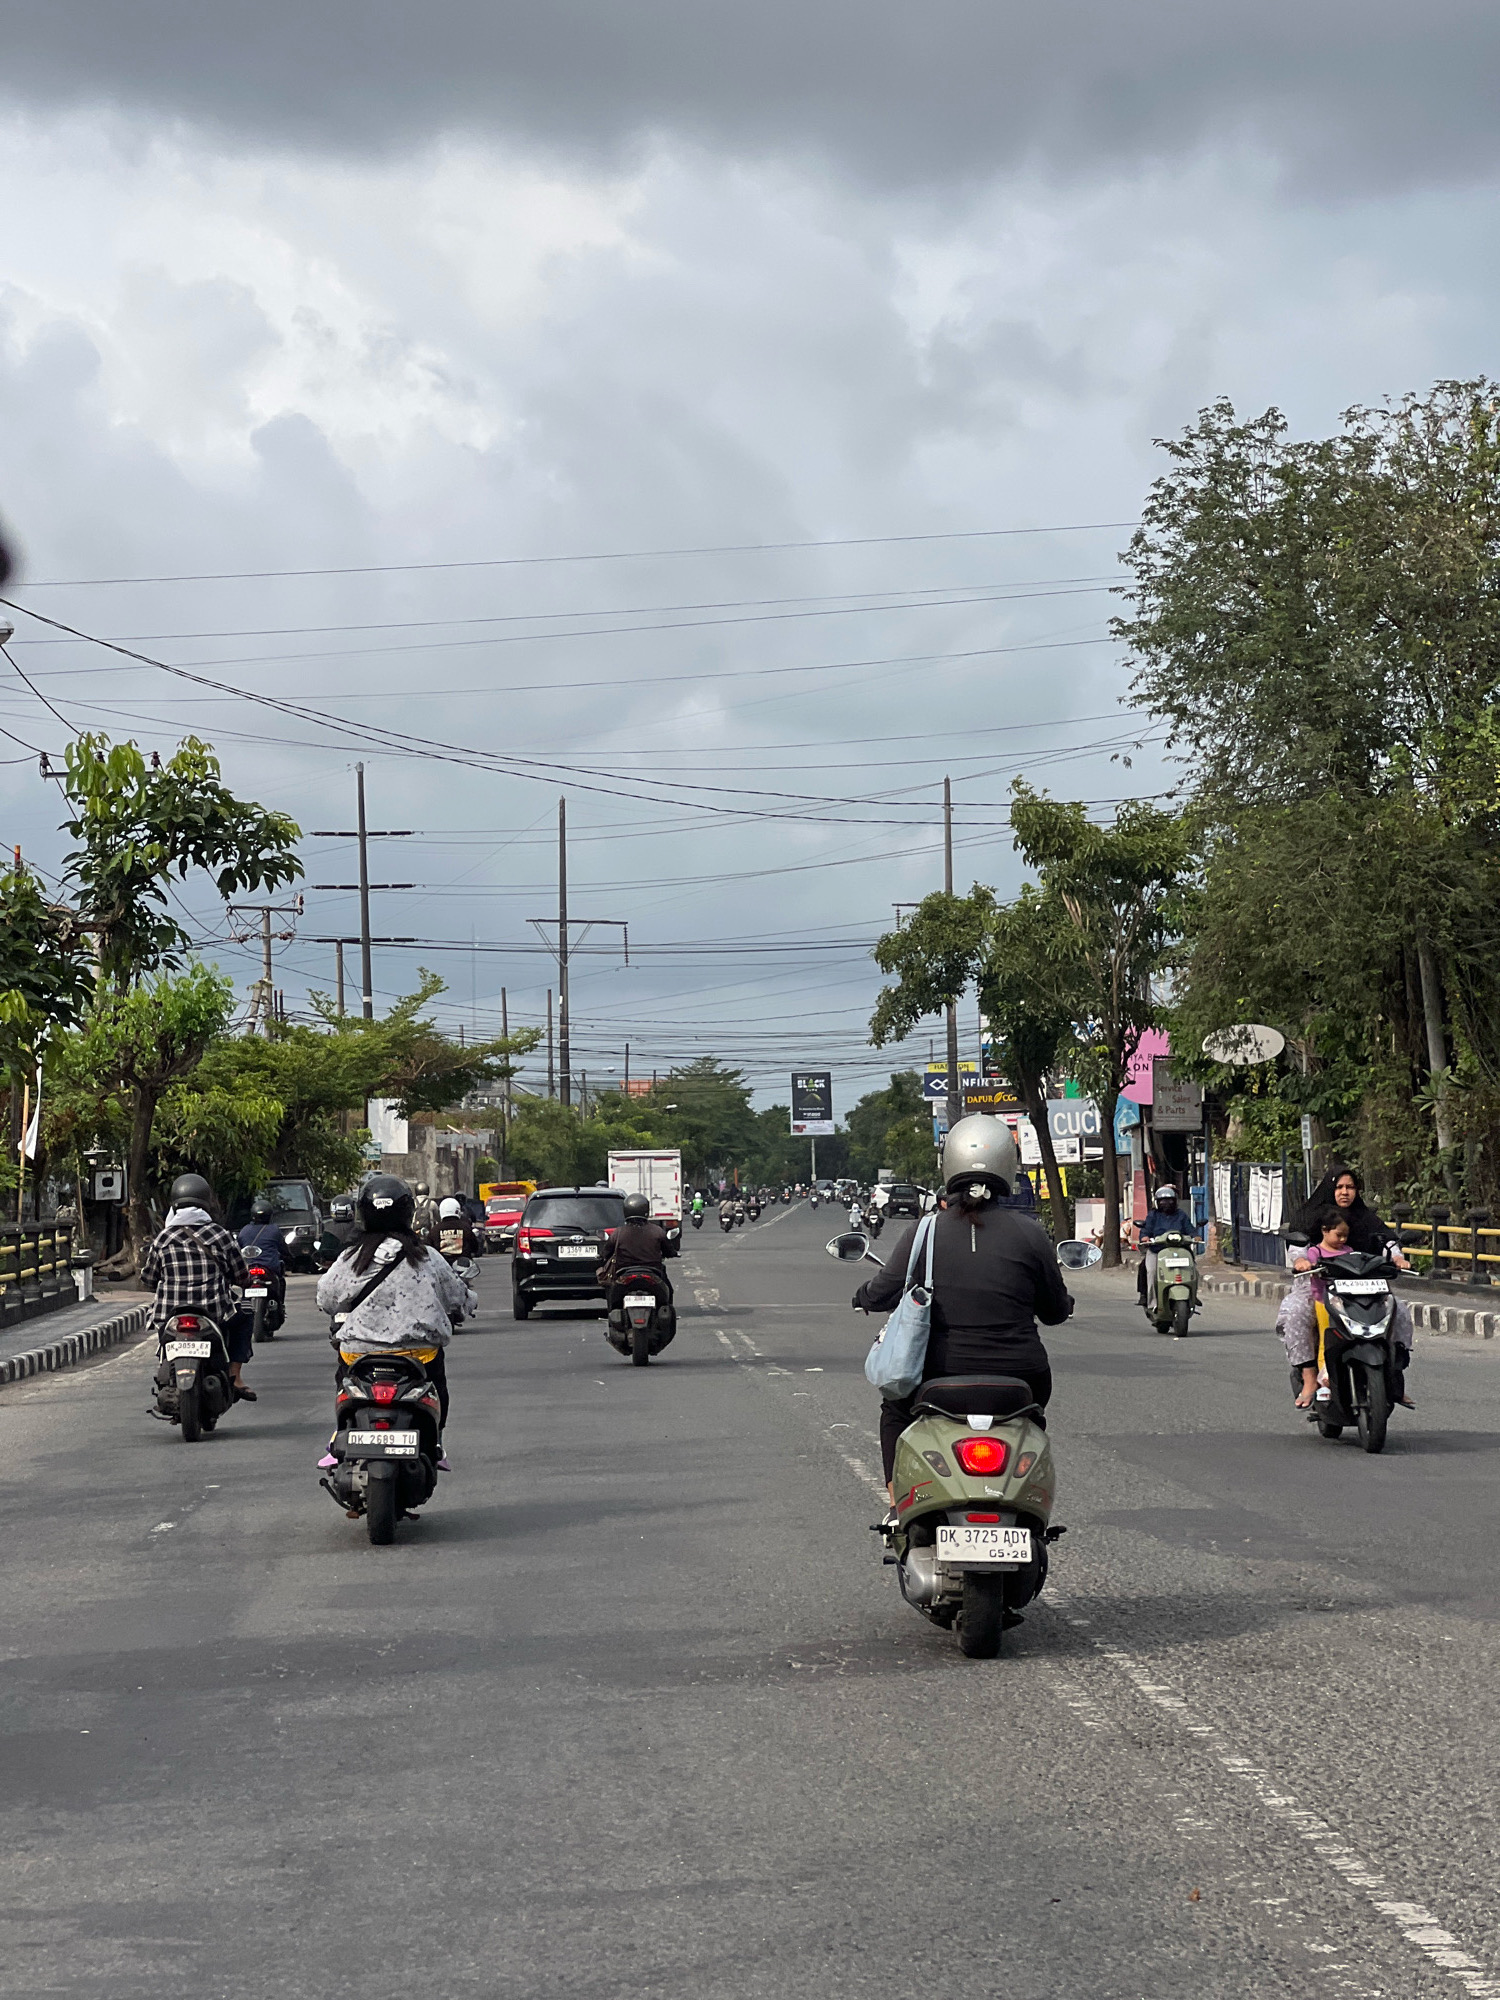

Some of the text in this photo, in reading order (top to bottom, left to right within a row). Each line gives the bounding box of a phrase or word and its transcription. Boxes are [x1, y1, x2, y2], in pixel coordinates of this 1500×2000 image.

[1156, 1083, 1183, 1093] Service
[1172, 1095, 1191, 1103] Sales
[1166, 1106, 1186, 1114] Parts
[351, 1434, 364, 1443] DK
[402, 1434, 415, 1444] TU
[940, 1529, 1027, 1544] DK 3725 ADY
